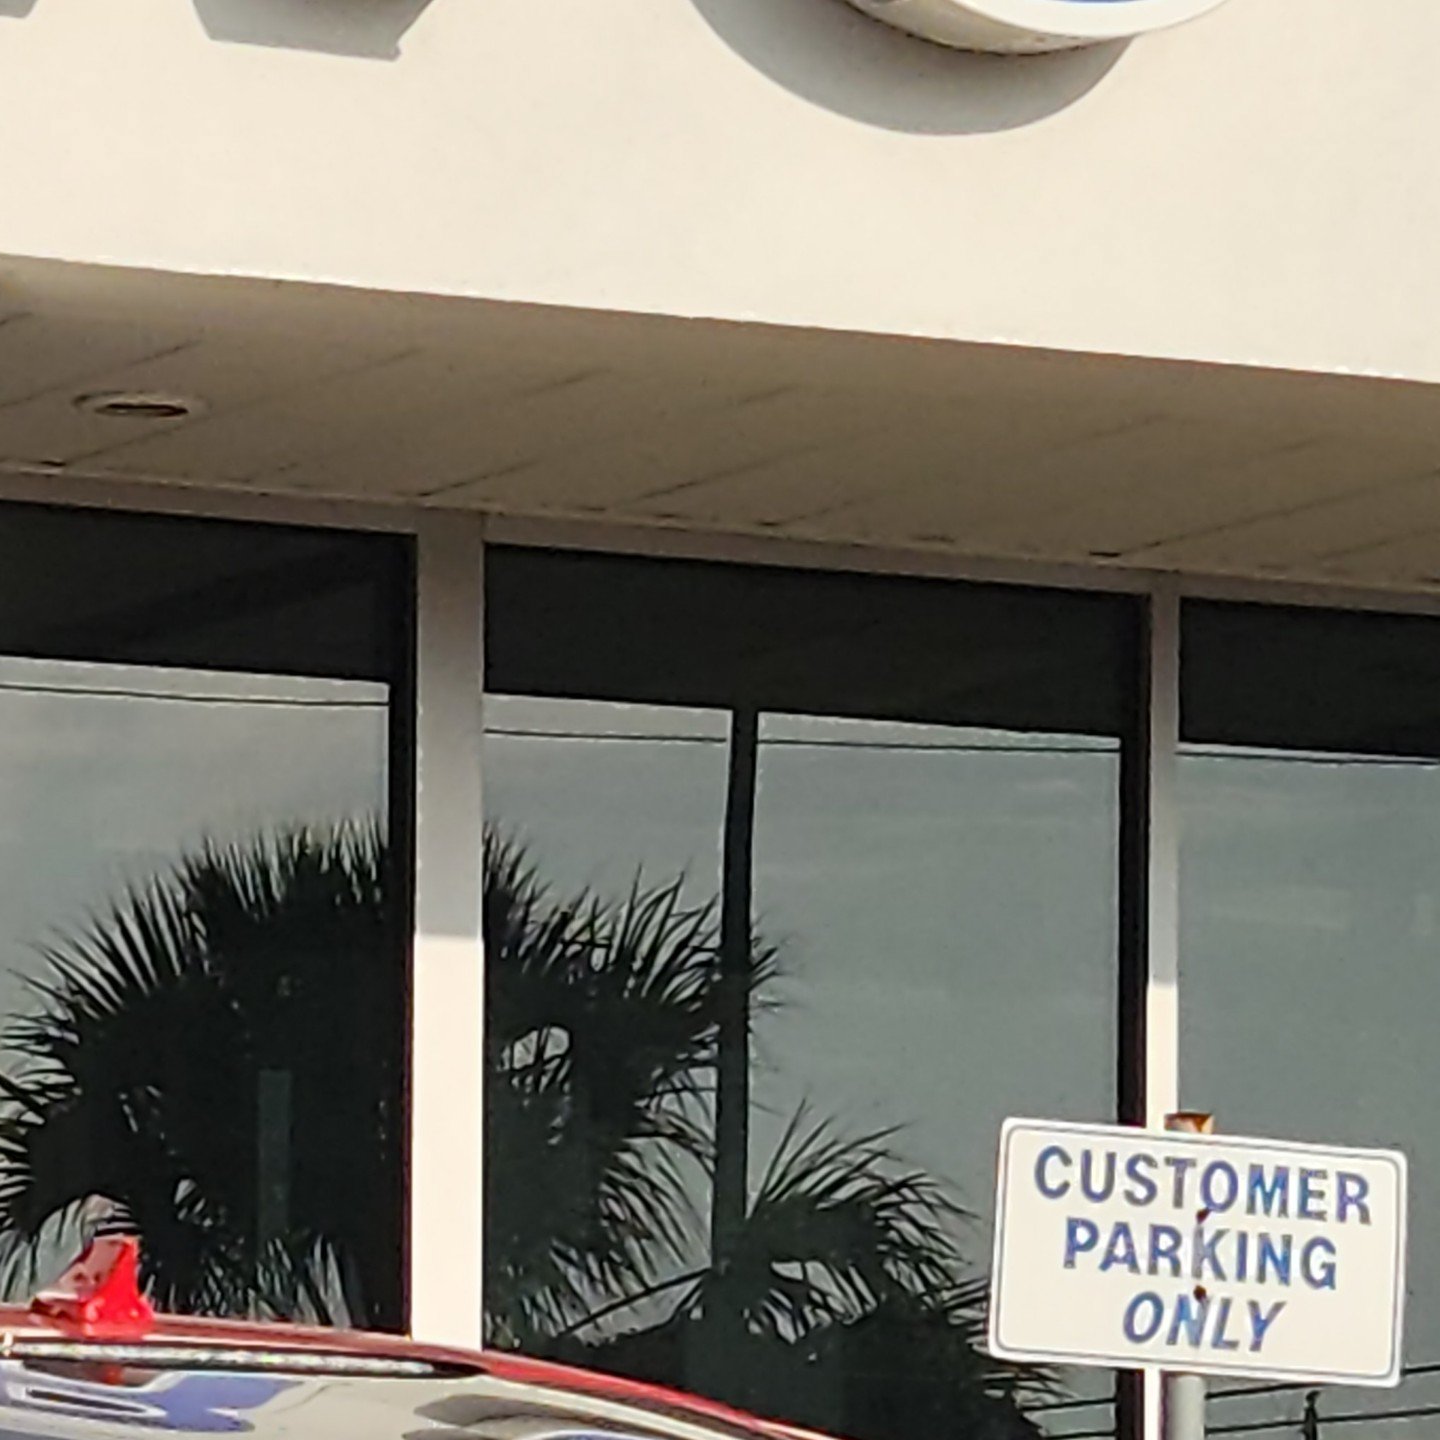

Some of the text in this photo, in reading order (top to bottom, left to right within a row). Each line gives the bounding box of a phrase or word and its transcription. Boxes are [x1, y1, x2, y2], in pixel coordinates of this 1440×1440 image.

[1034, 1145, 1372, 1225] CUSTOMER
[1063, 1217, 1336, 1291] PARKING
[1123, 1290, 1286, 1352] ONLY
